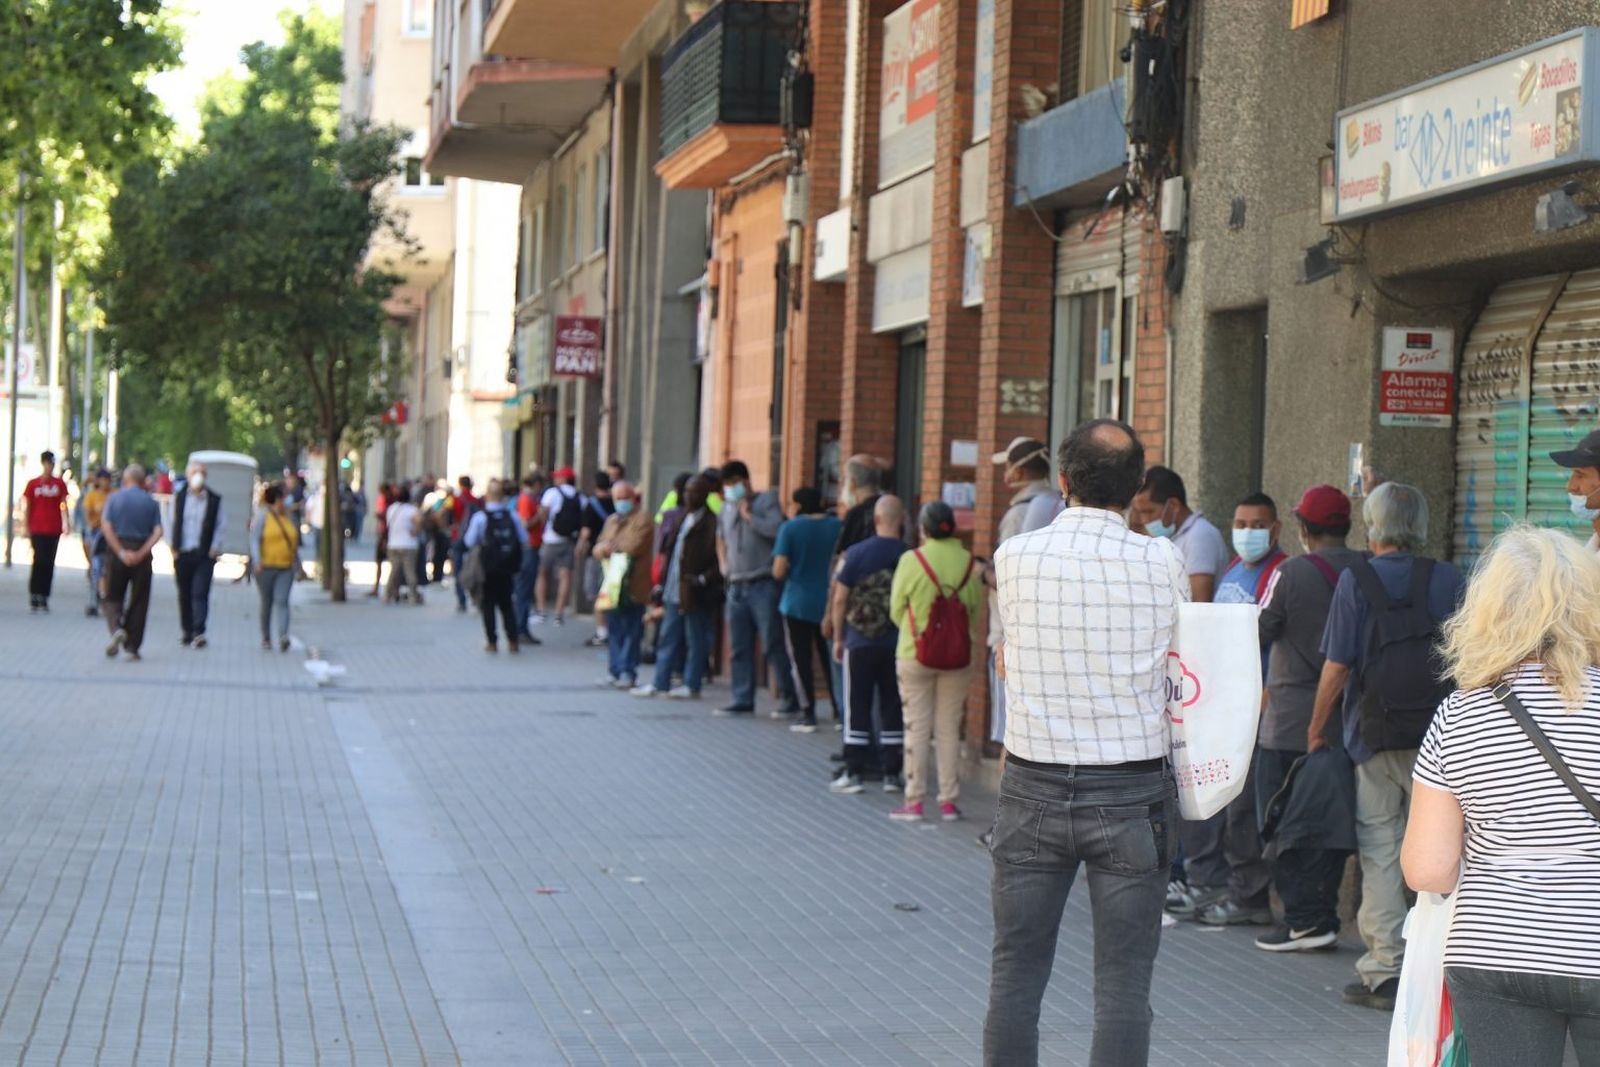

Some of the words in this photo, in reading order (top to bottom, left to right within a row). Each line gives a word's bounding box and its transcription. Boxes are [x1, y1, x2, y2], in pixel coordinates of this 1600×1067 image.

[1395, 106, 1413, 152] bar
[1441, 96, 1512, 181] 2veinte
[555, 355, 595, 373] PAN
[1387, 372, 1448, 388] Alarma
[1386, 387, 1448, 399] conectada
